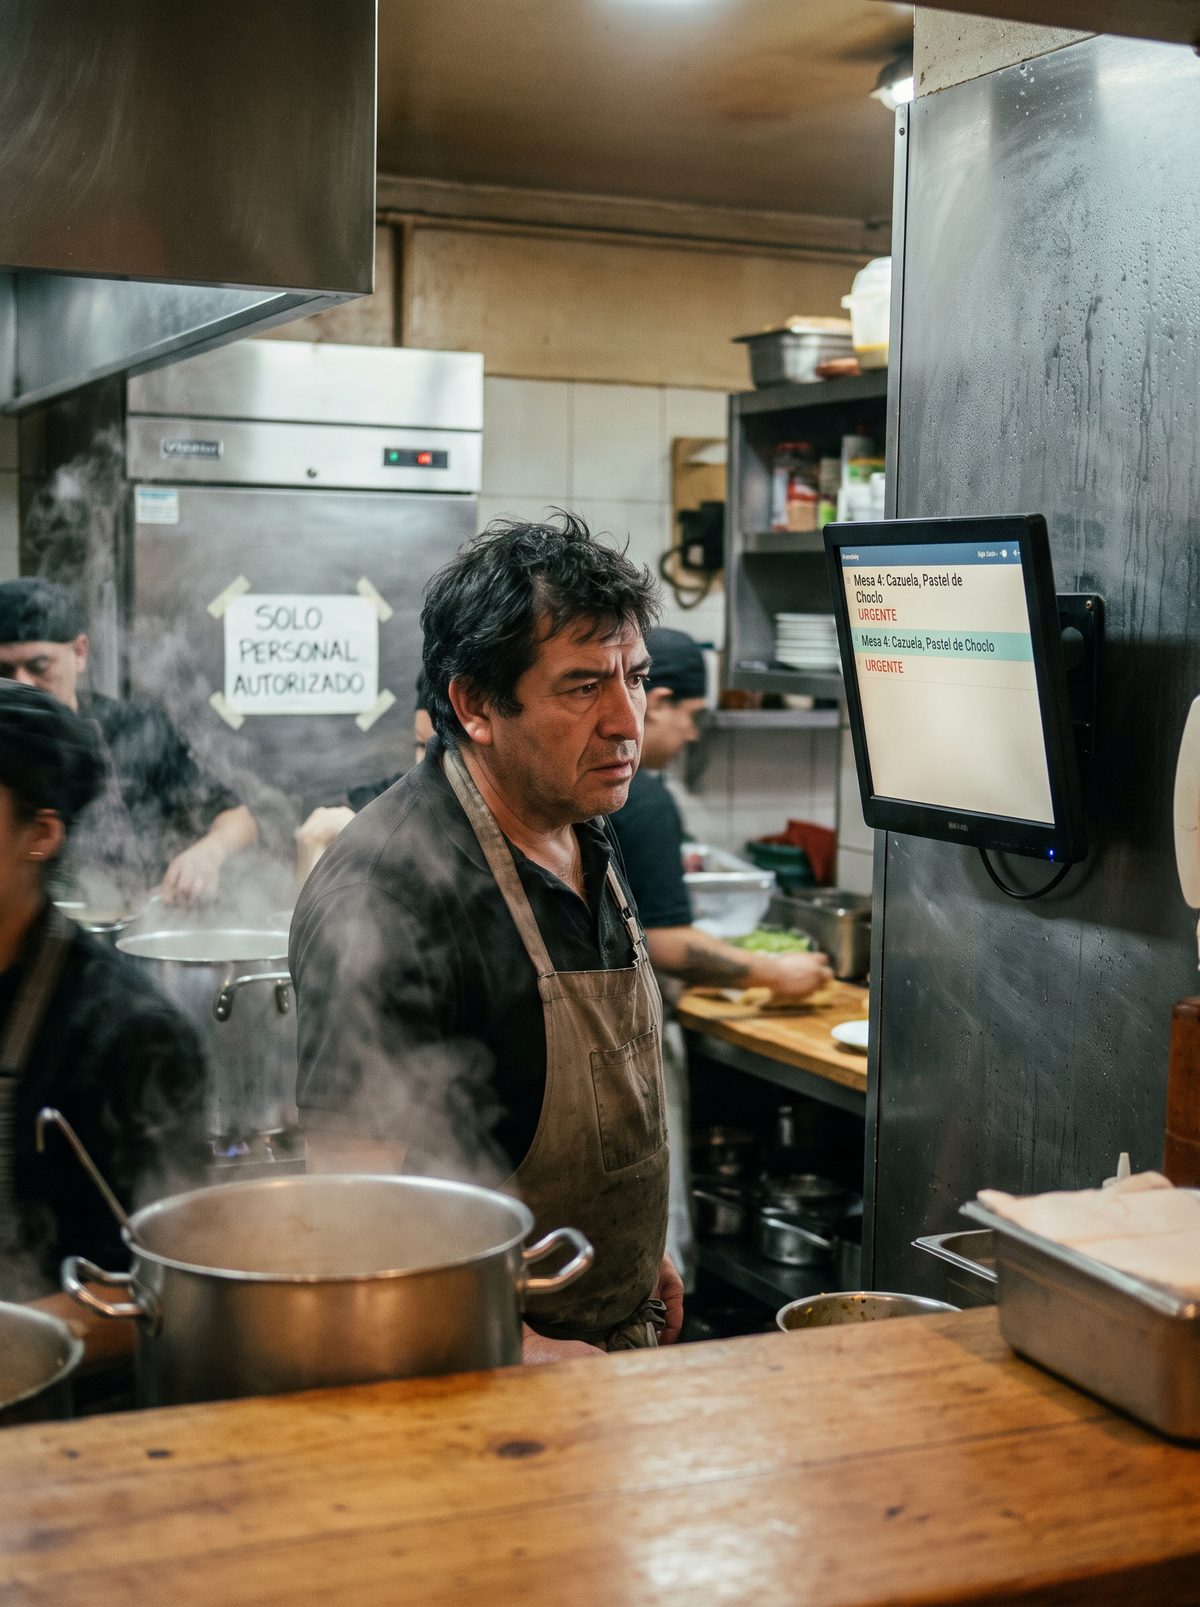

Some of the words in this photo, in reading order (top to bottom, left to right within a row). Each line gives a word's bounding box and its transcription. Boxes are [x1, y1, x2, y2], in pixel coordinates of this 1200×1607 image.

[854, 573, 876, 587] Mesa
[877, 573, 885, 587] 4:
[887, 573, 922, 589] Cazuela,
[922, 573, 950, 587] Pastel
[952, 573, 963, 587] de
[856, 591, 883, 603] Choclo
[255, 604, 323, 631] SOLO
[858, 608, 897, 621] URGENTE
[239, 638, 359, 664] PERSONAL
[861, 634, 882, 647] Mesa
[883, 635, 891, 648] 4:
[892, 635, 925, 651] Cazuela,
[926, 637, 952, 651] Pastel
[953, 637, 963, 651] de
[965, 638, 995, 652] Choclo
[865, 659, 904, 673] URGENTE
[233, 672, 365, 696] AUTORIZADO
